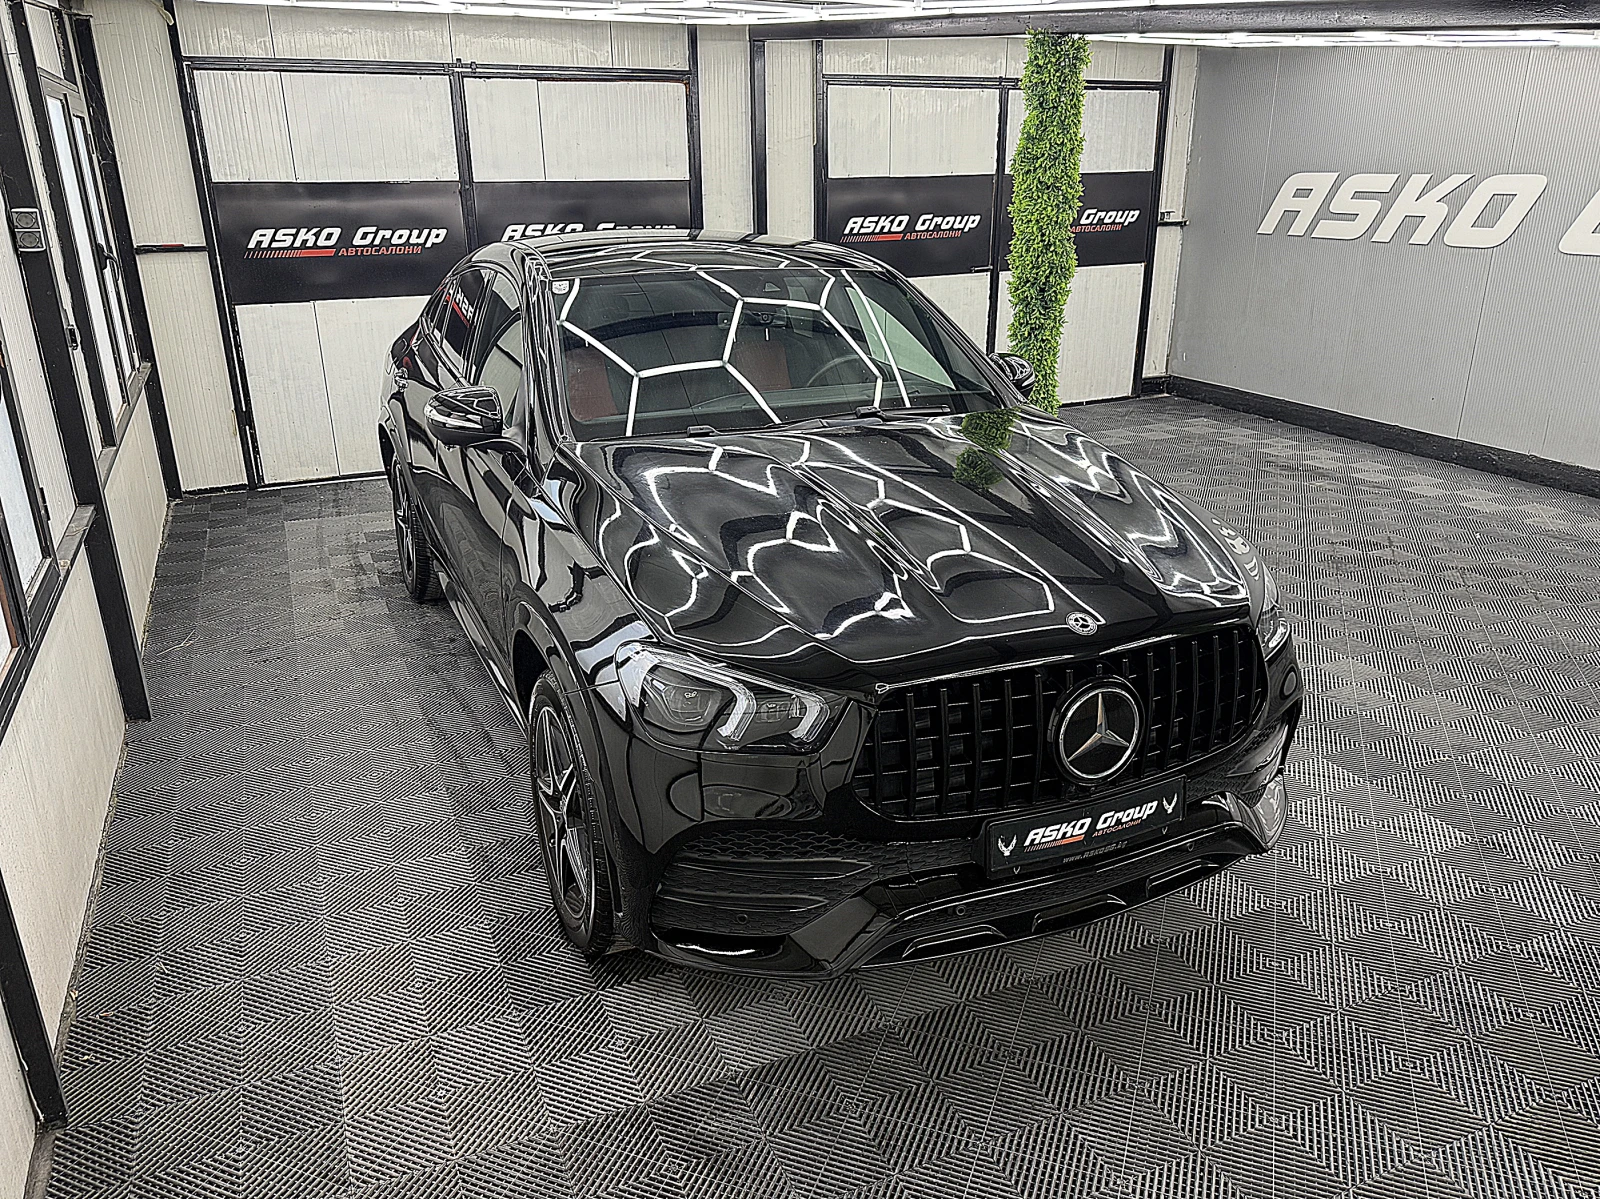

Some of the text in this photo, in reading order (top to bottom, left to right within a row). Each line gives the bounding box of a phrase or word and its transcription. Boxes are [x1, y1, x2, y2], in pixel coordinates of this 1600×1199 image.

[1080, 208, 1140, 226] Group
[1256, 171, 1548, 249] ASKO
[843, 213, 981, 234] ASKO Group
[1070, 224, 1122, 233] АВТОСАЛОНИ
[247, 226, 448, 248] ASKO Group
[904, 230, 962, 240] АВТОСАЛОНИ
[338, 245, 422, 256] АВТОСАЛОНИ
[1024, 800, 1158, 847] ASKO Group
